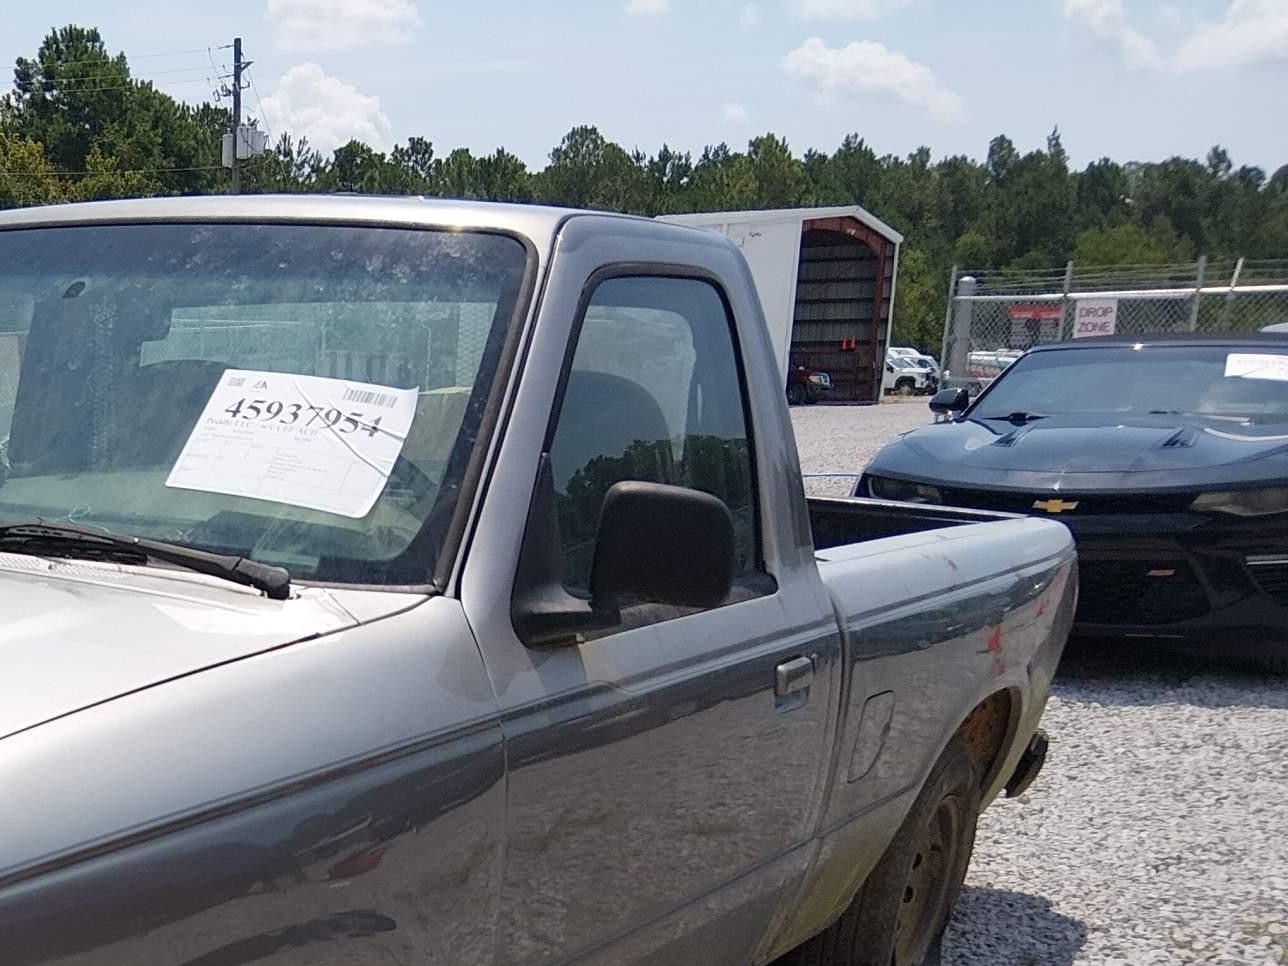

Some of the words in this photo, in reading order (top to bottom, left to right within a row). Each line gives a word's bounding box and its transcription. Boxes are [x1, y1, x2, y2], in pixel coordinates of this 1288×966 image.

[1079, 306, 1113, 318] DROP
[1078, 321, 1112, 332] ZONE
[224, 397, 383, 437] 45937954
